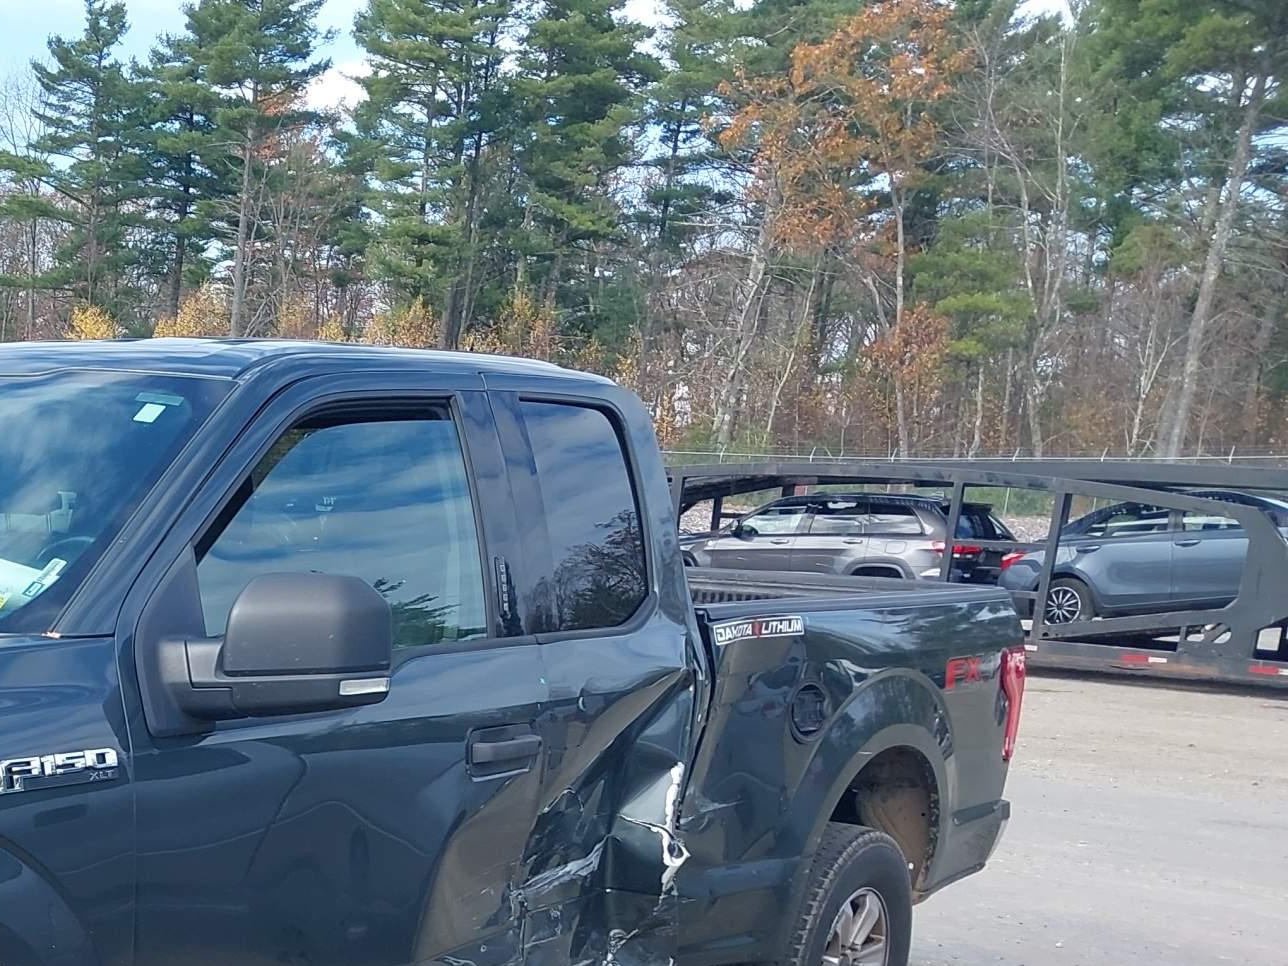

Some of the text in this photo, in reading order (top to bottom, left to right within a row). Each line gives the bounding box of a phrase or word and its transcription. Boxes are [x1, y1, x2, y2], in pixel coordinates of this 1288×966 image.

[716, 619, 802, 641] DAKOTA LITHIUM
[945, 654, 992, 689] FX
[89, 769, 115, 782] XLT
